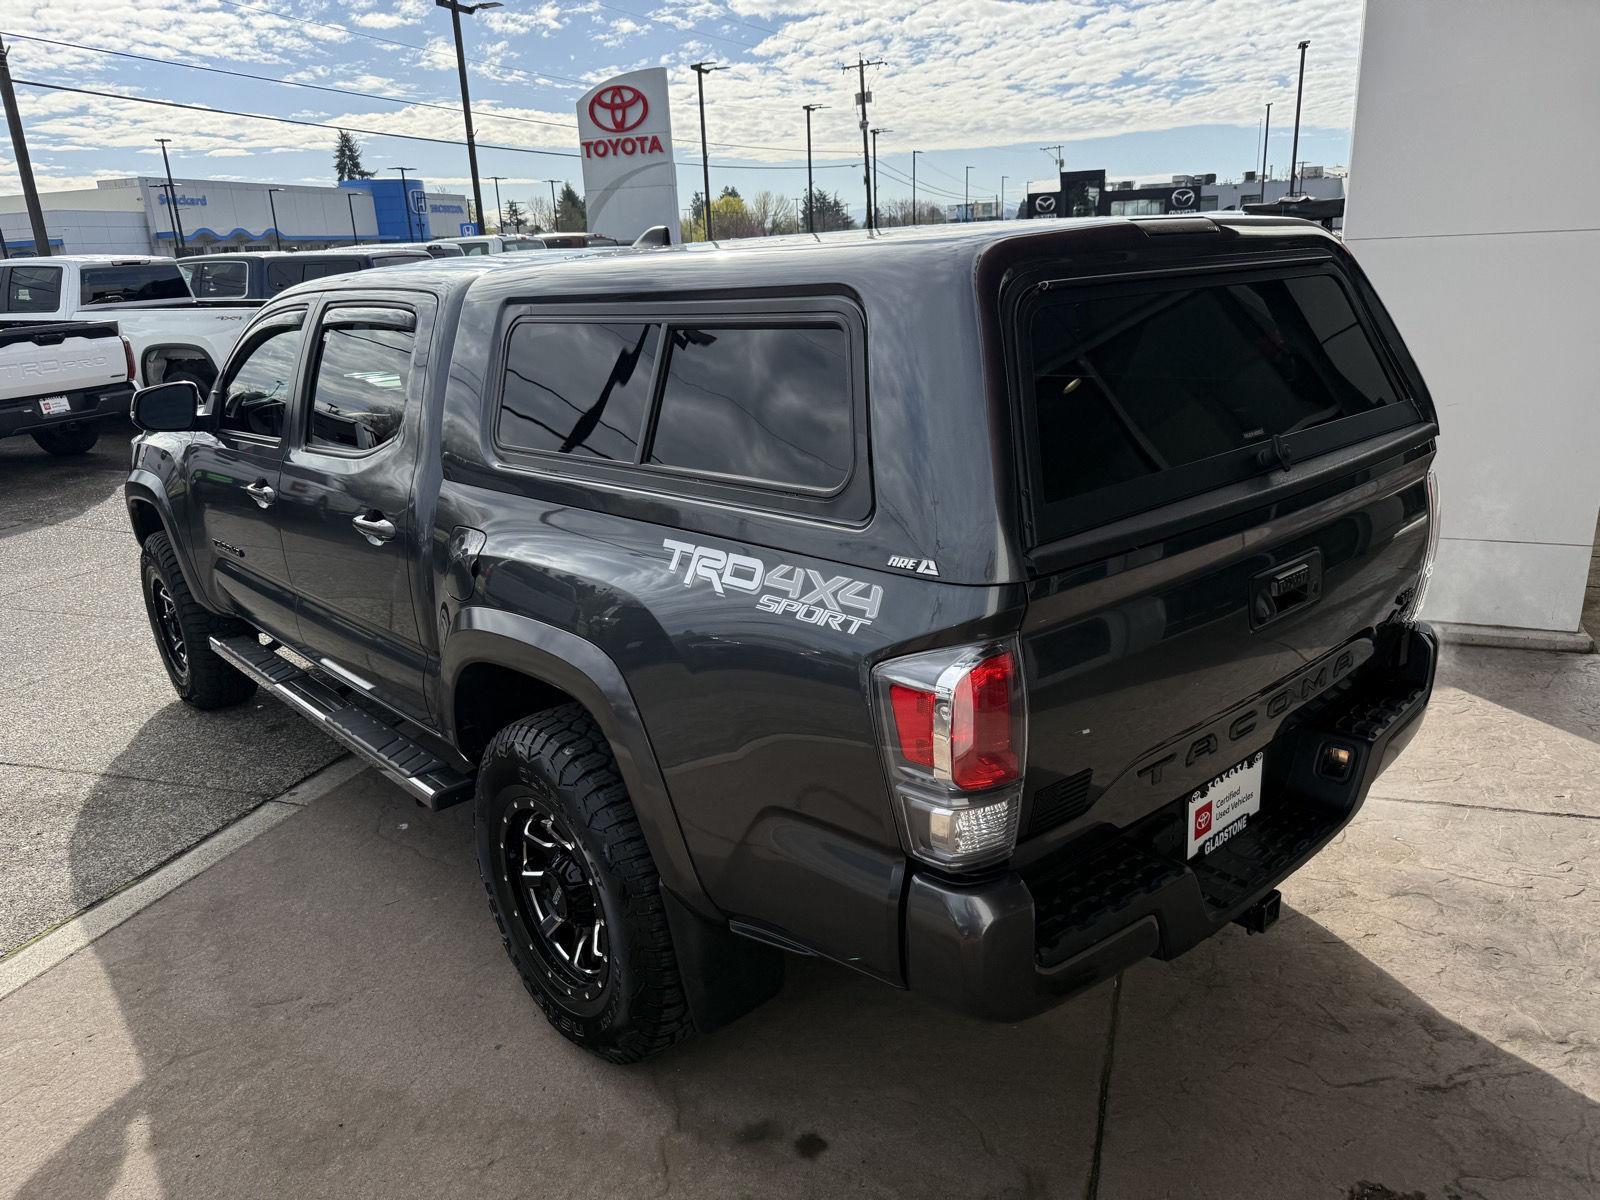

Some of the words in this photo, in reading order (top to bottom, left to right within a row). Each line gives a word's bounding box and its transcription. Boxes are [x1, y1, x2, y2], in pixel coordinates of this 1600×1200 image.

[581, 135, 664, 159] TOYOTA
[0, 359, 61, 379] TRD
[662, 538, 765, 598] TRD
[763, 564, 884, 620] 4X4
[755, 594, 873, 635] SPORT
[1136, 653, 1355, 787] TACOMA
[1207, 760, 1249, 792] TOYOTA
[1215, 785, 1241, 809] Certified
[1215, 804, 1231, 821] Used
[1230, 791, 1254, 811] Vehicles
[1204, 814, 1248, 855] GLADSTONE
